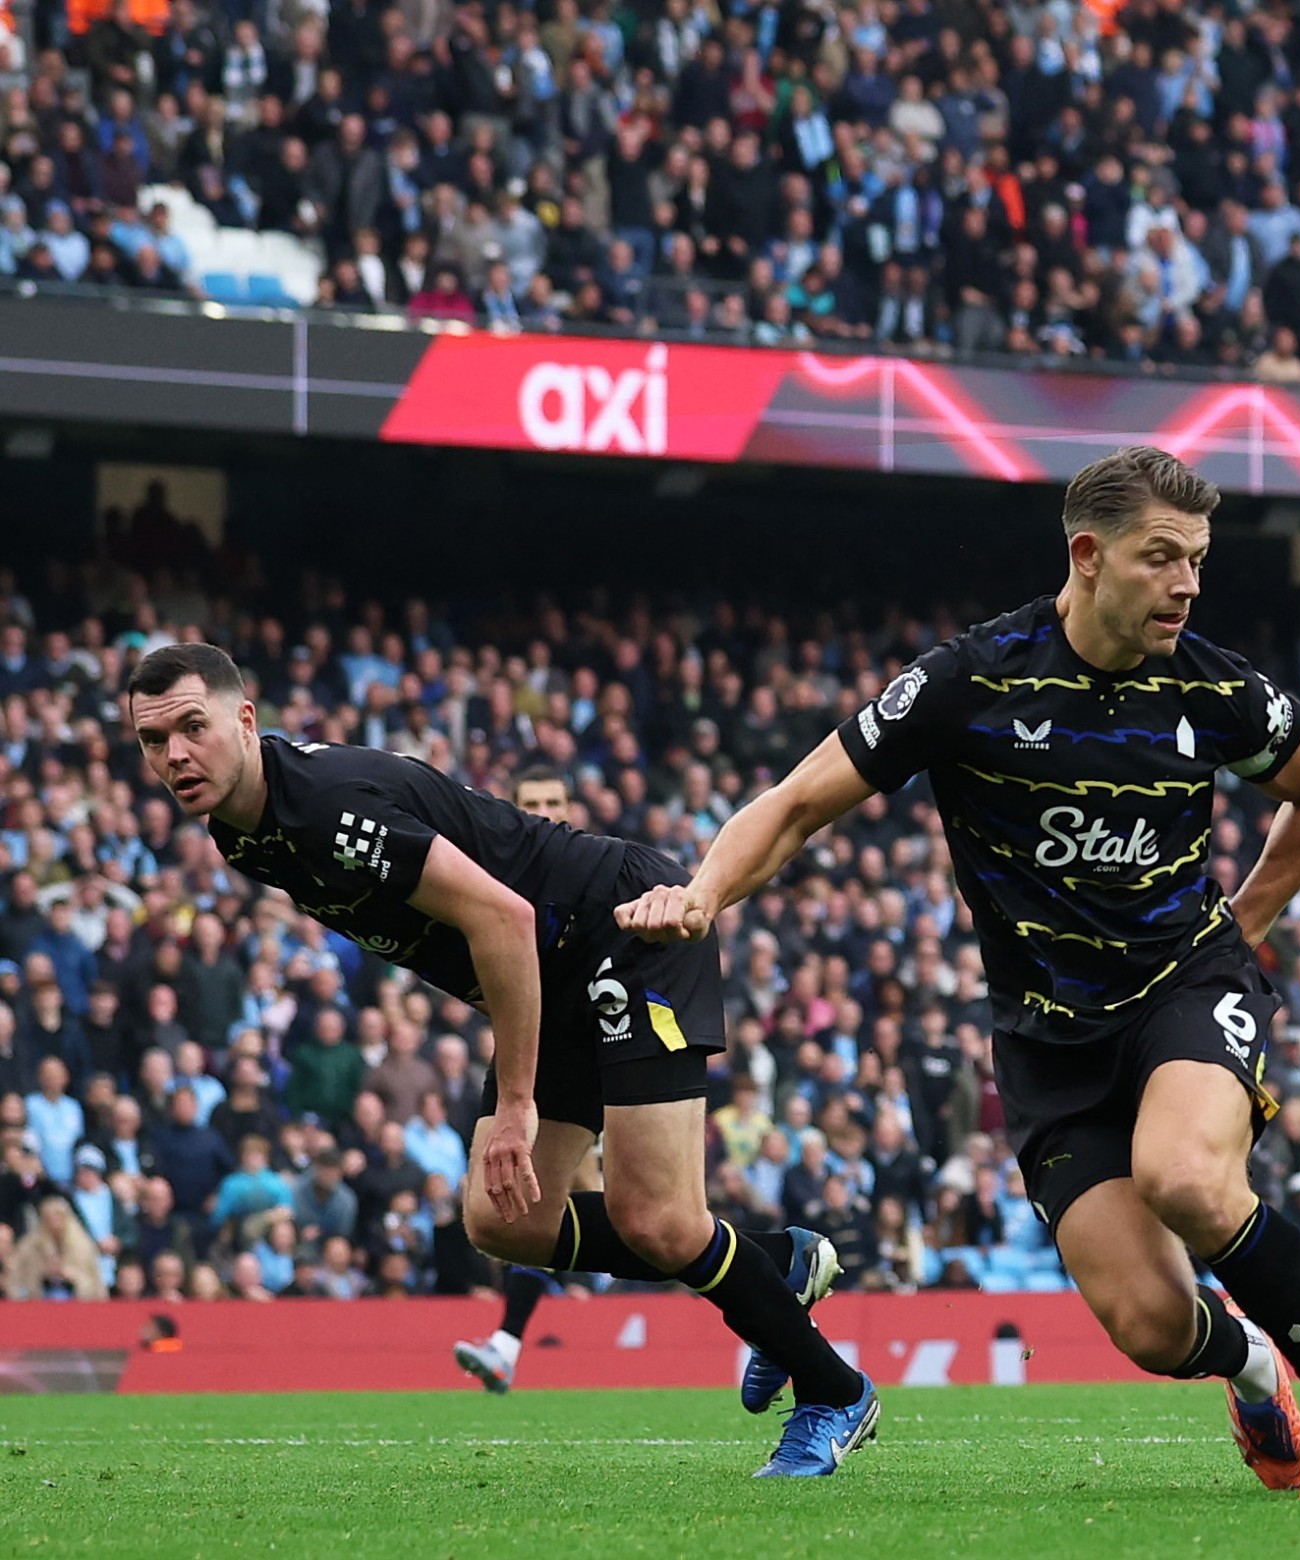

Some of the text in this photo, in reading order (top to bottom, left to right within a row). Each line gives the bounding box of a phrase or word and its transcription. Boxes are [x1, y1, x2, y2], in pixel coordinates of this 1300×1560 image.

[518, 341, 668, 456] axi
[1093, 864, 1120, 873] .com
[1213, 992, 1256, 1042] 6
